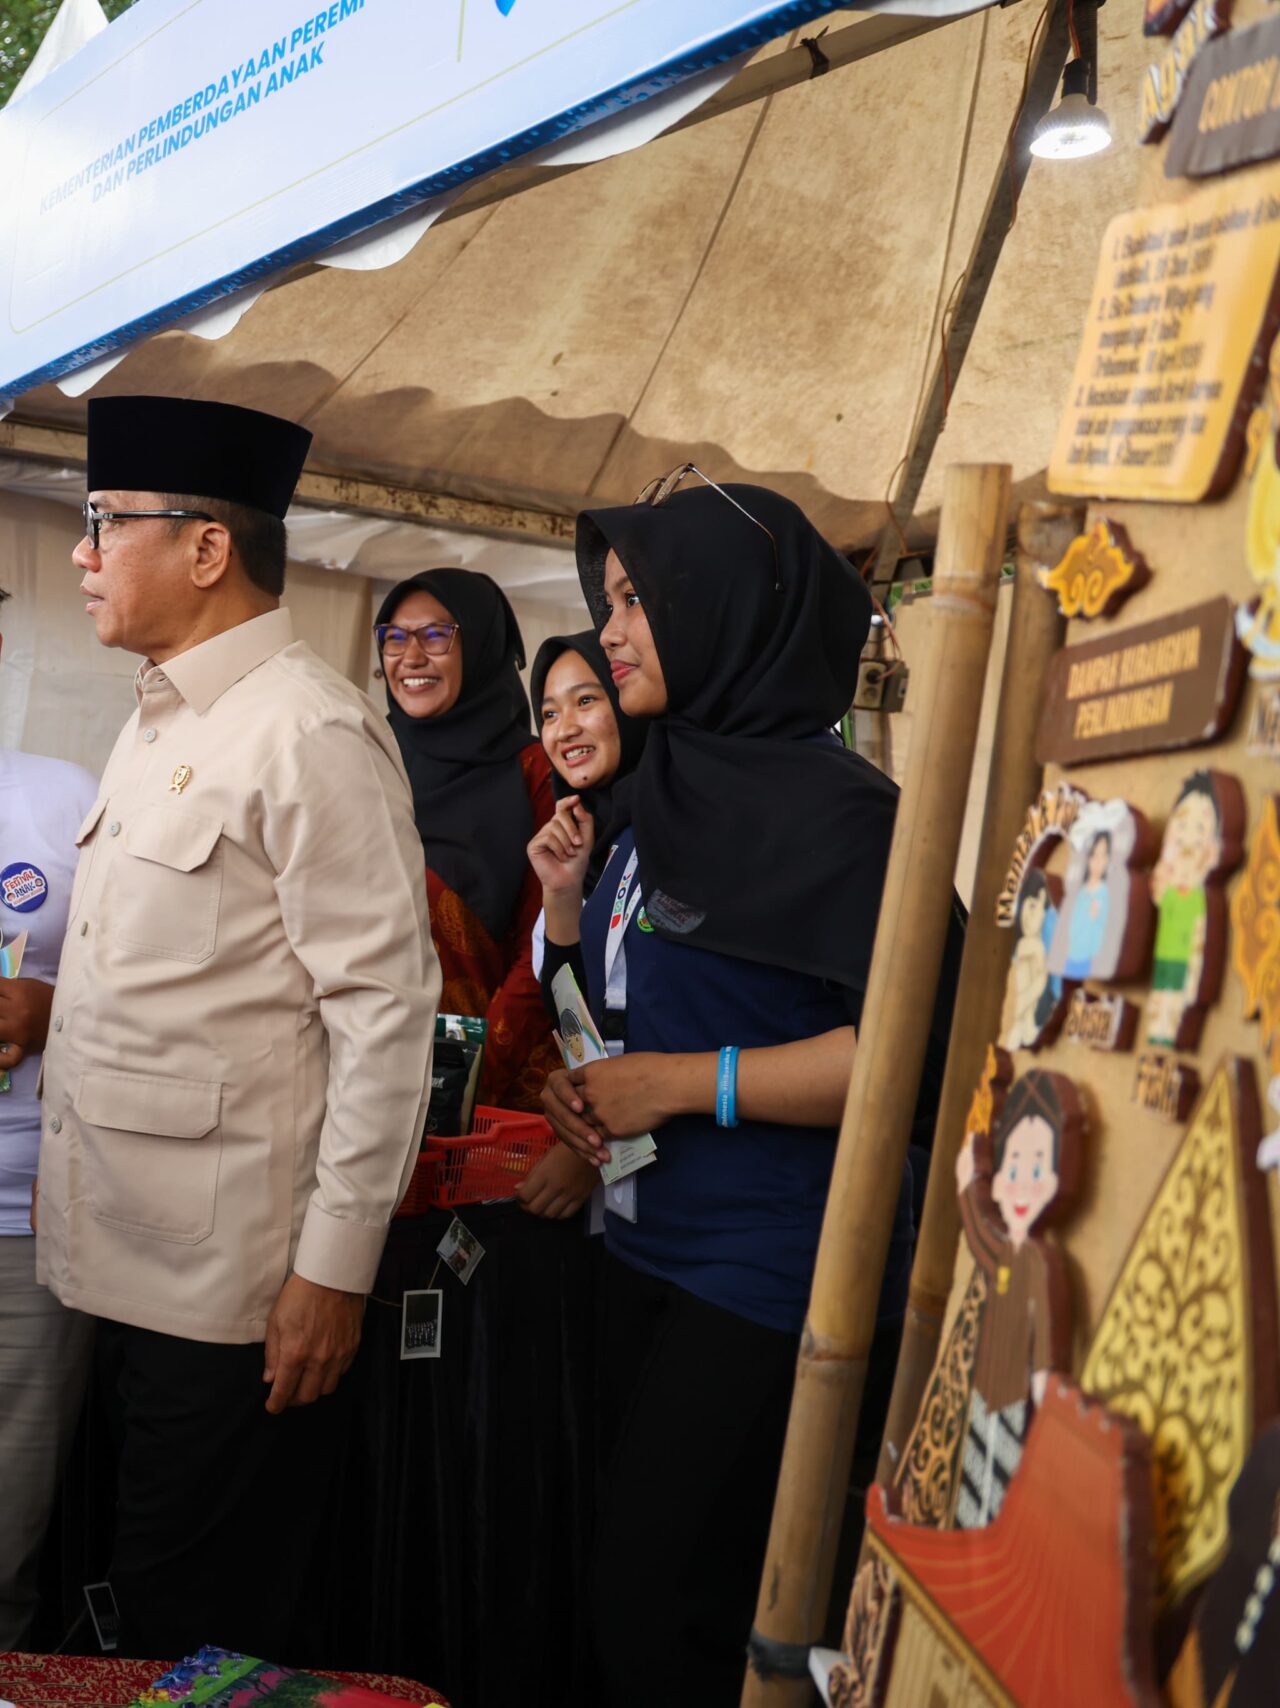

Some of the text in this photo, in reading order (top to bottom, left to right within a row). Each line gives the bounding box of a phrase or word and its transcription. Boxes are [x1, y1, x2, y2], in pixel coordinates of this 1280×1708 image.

[39, 133, 135, 216] KEMENTERIAN
[138, 36, 287, 149] PEMBERDAYAAN
[92, 40, 325, 204] DAN PERLINDUNGAN ANAK
[4, 870, 36, 892] FESTIVAL
[14, 881, 36, 898] ANAK
